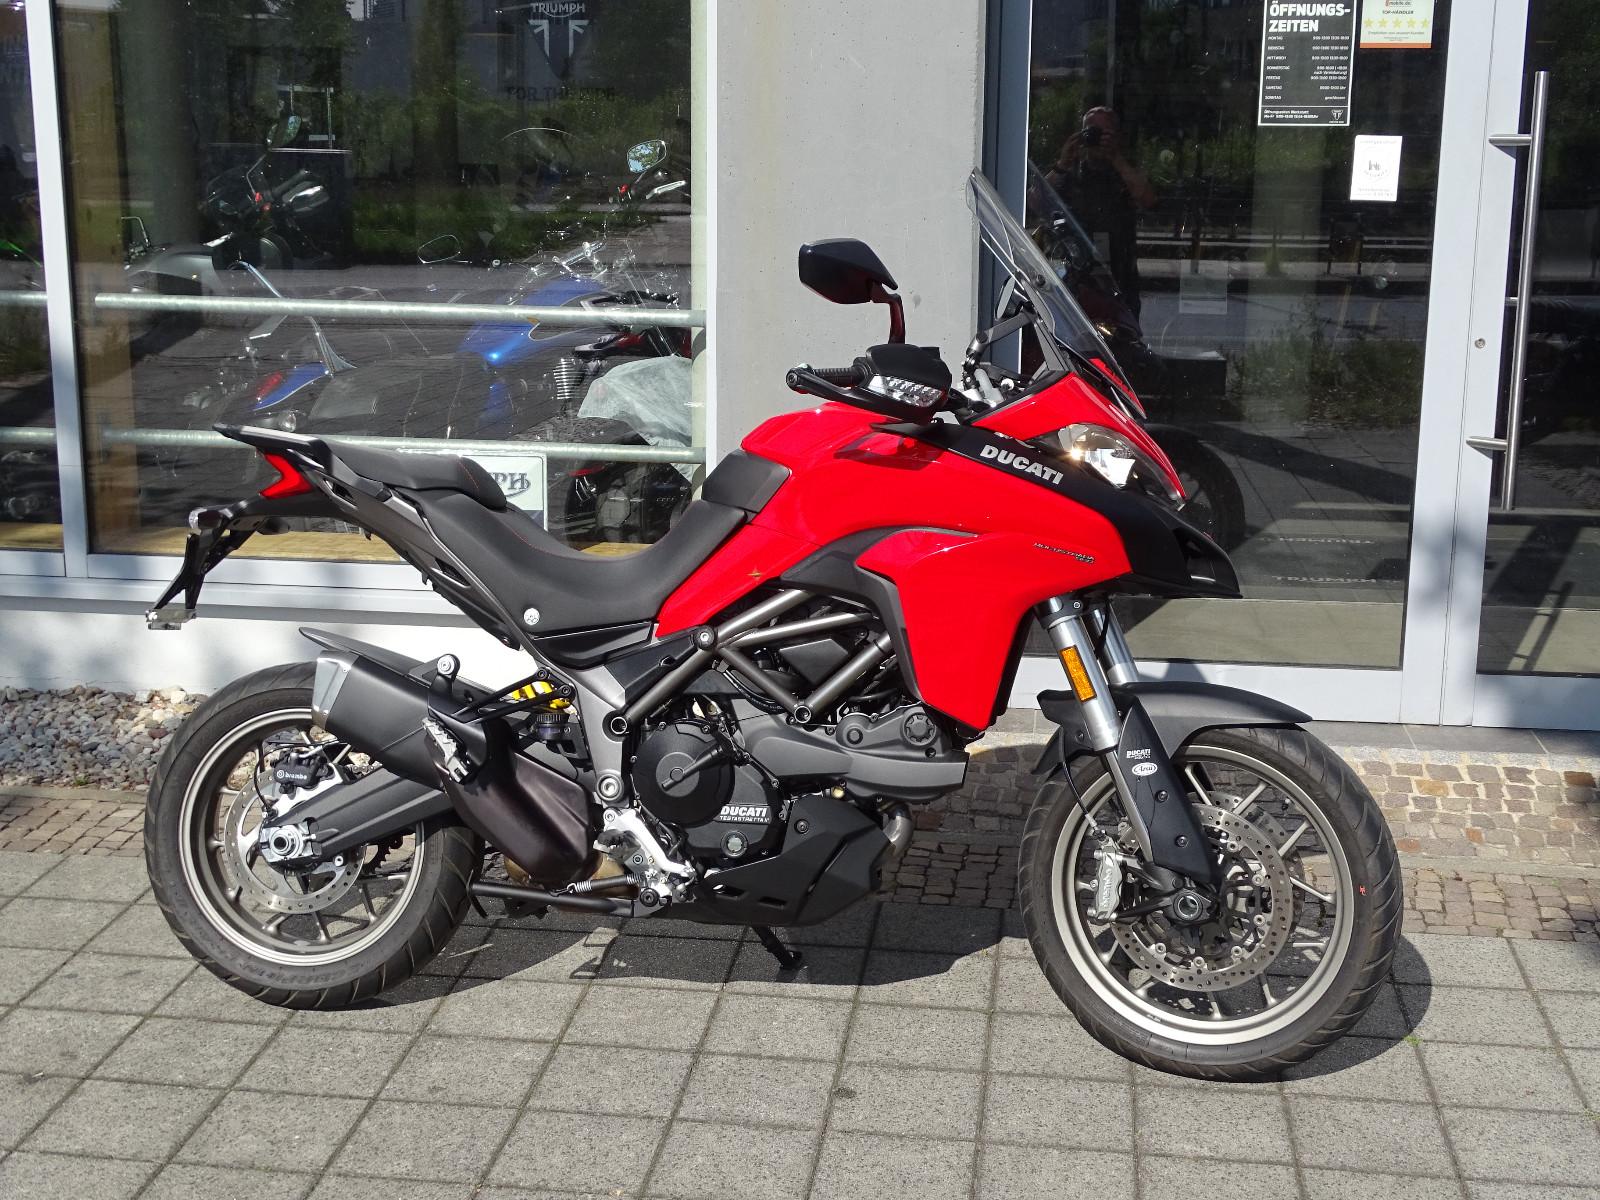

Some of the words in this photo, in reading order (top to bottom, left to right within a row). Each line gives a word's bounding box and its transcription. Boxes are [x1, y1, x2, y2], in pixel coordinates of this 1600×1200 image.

[531, 3, 585, 13] TRIUMPH
[1269, 1, 1351, 17] ÖFFNUNGS-
[1268, 20, 1319, 32] ZEITEN
[980, 444, 1064, 485] DUCATI
[1126, 748, 1151, 756] DUCATI
[720, 805, 768, 817] DUCATI
